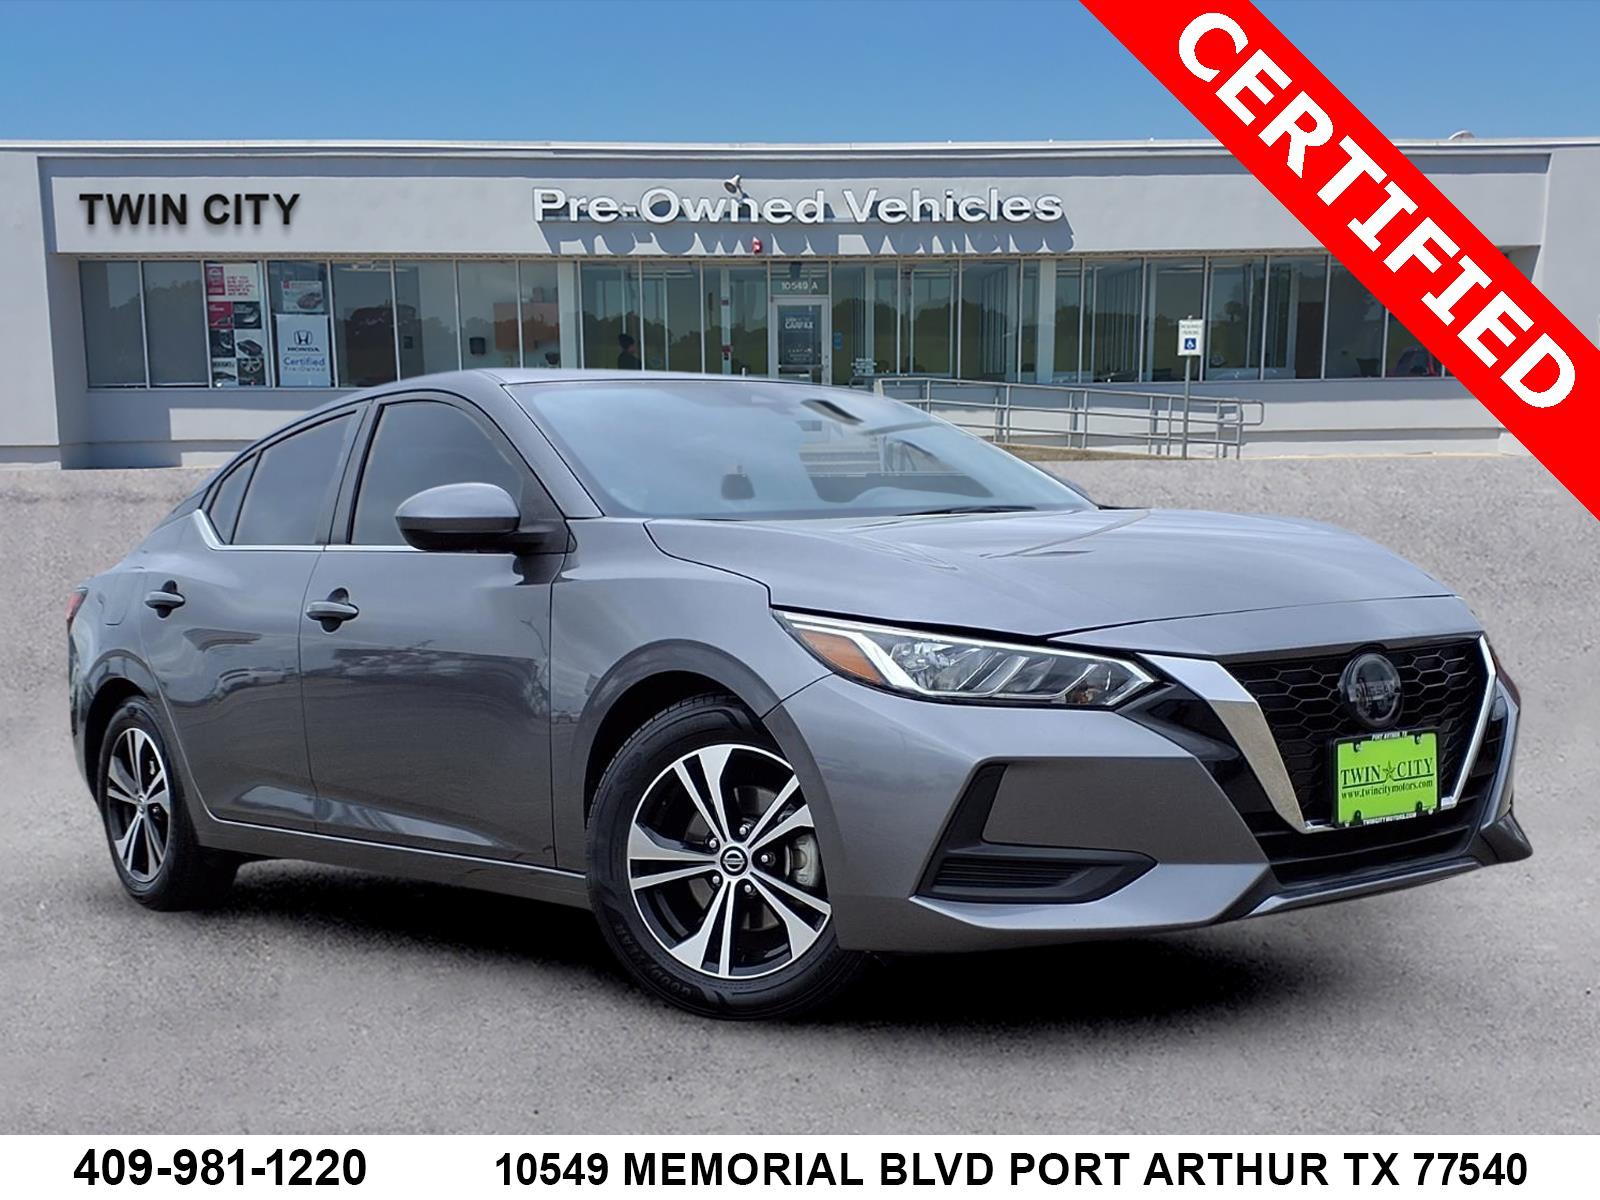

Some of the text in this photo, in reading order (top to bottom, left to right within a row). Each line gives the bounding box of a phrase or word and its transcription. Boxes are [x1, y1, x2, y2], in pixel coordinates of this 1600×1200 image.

[79, 194, 300, 225] TWIN CITY
[533, 188, 1064, 224] Pre-Owned Vehicles
[782, 281, 808, 290] 10549
[283, 357, 325, 367] Certified
[1341, 757, 1433, 786] TWIN CITY
[1341, 779, 1433, 800] www.twincitymotors.com
